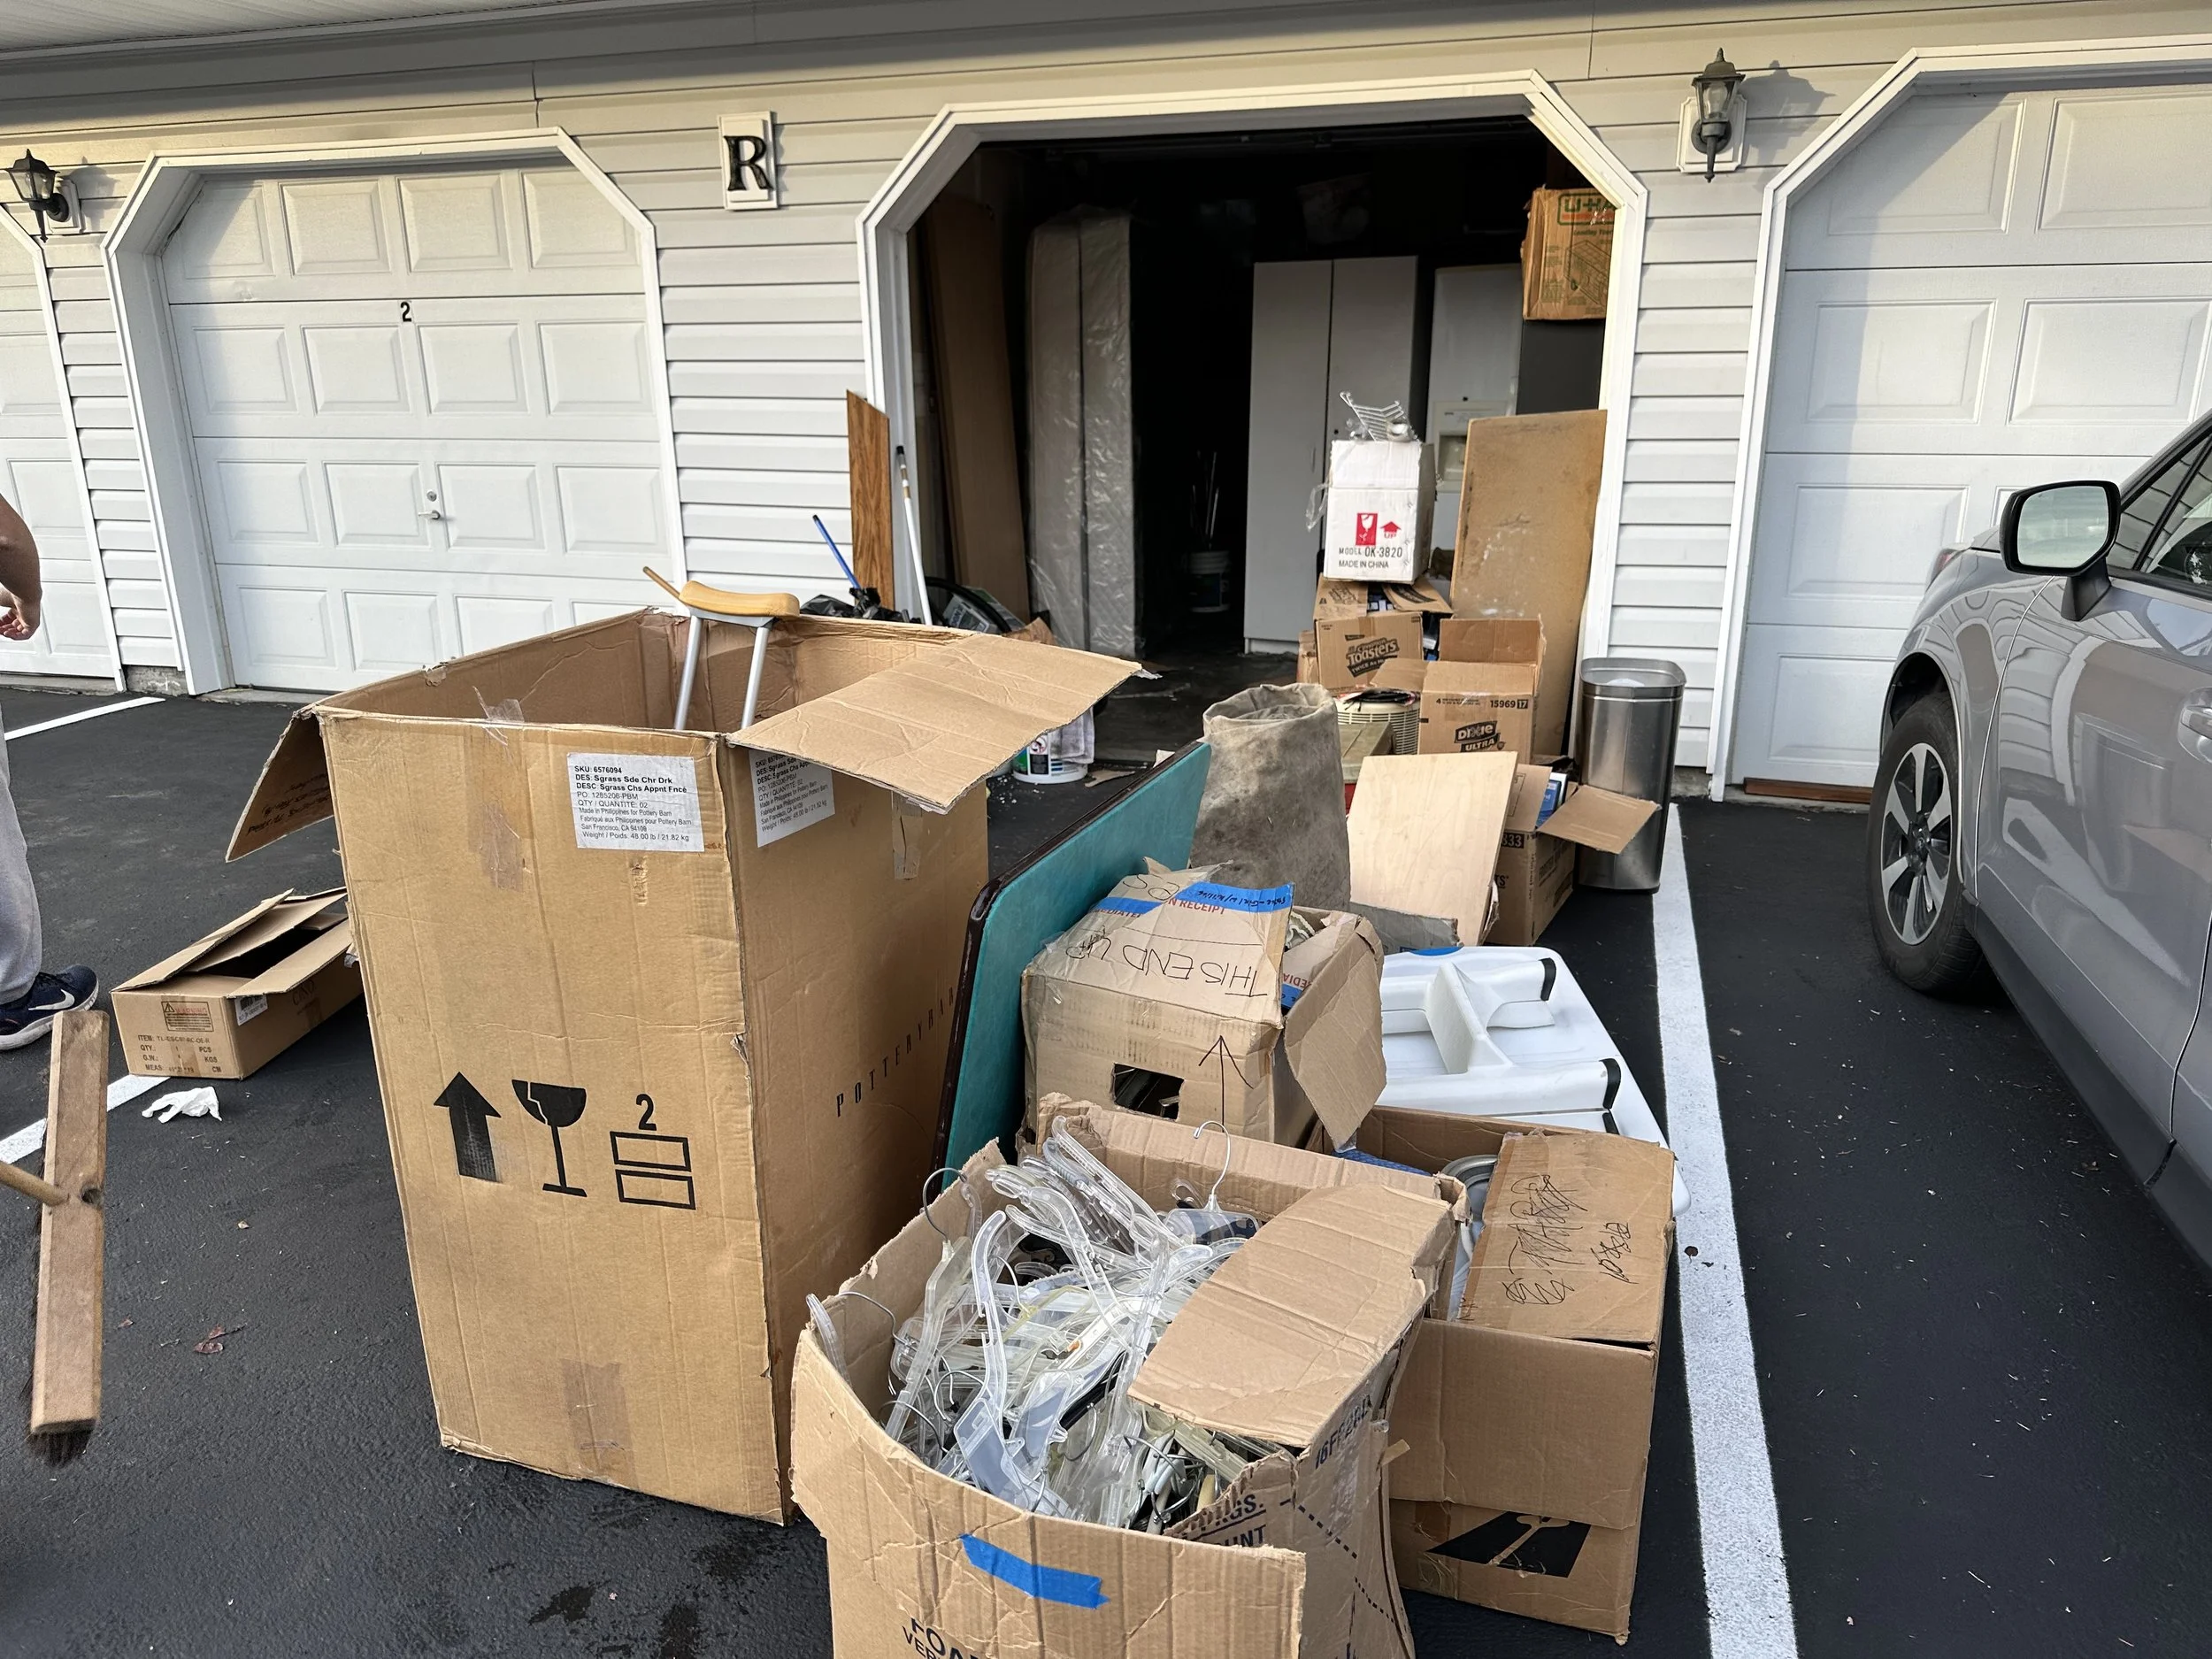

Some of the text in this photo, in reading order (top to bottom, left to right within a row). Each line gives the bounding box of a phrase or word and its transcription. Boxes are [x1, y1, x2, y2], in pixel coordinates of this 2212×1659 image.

[723, 135, 772, 192] R
[400, 302, 412, 322] 2
[1348, 641, 1396, 665] Toasters
[1490, 699, 1516, 708] 15969
[1465, 738, 1495, 751] ULTRA
[594, 774, 621, 783] Sgrass
[1123, 944, 1194, 980] END
[1201, 962, 1268, 997] THIS
[635, 1093, 657, 1131] 2
